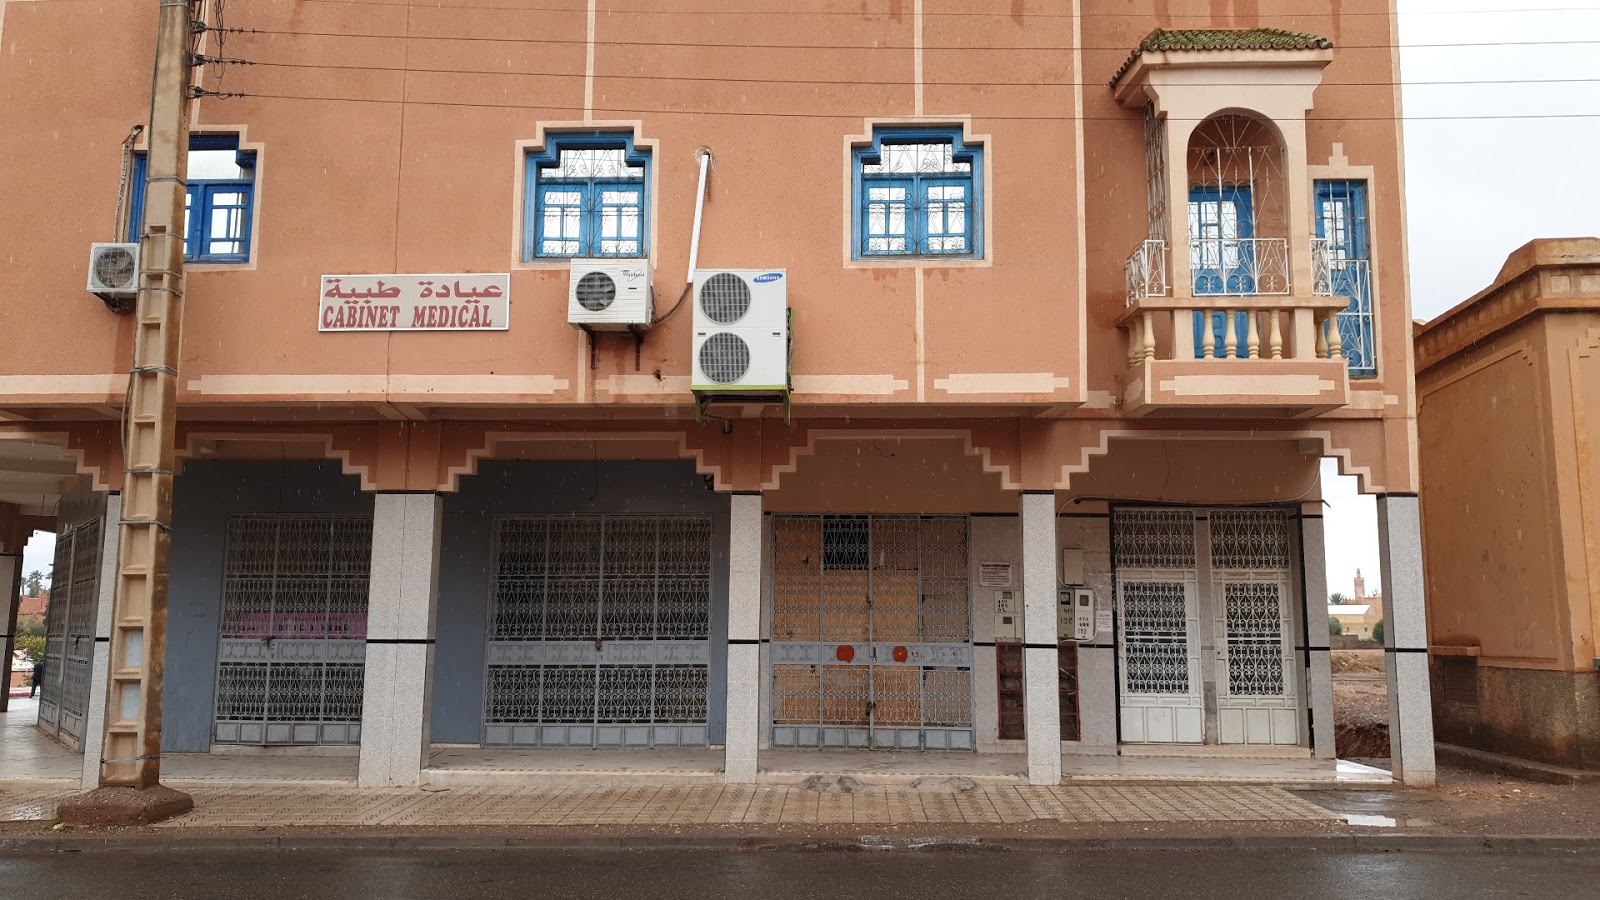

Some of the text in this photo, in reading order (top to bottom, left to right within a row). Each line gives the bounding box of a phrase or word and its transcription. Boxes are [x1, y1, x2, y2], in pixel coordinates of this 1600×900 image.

[324, 278, 503, 305] عيادة طبية
[322, 305, 493, 328] CABINET MEDICAL
